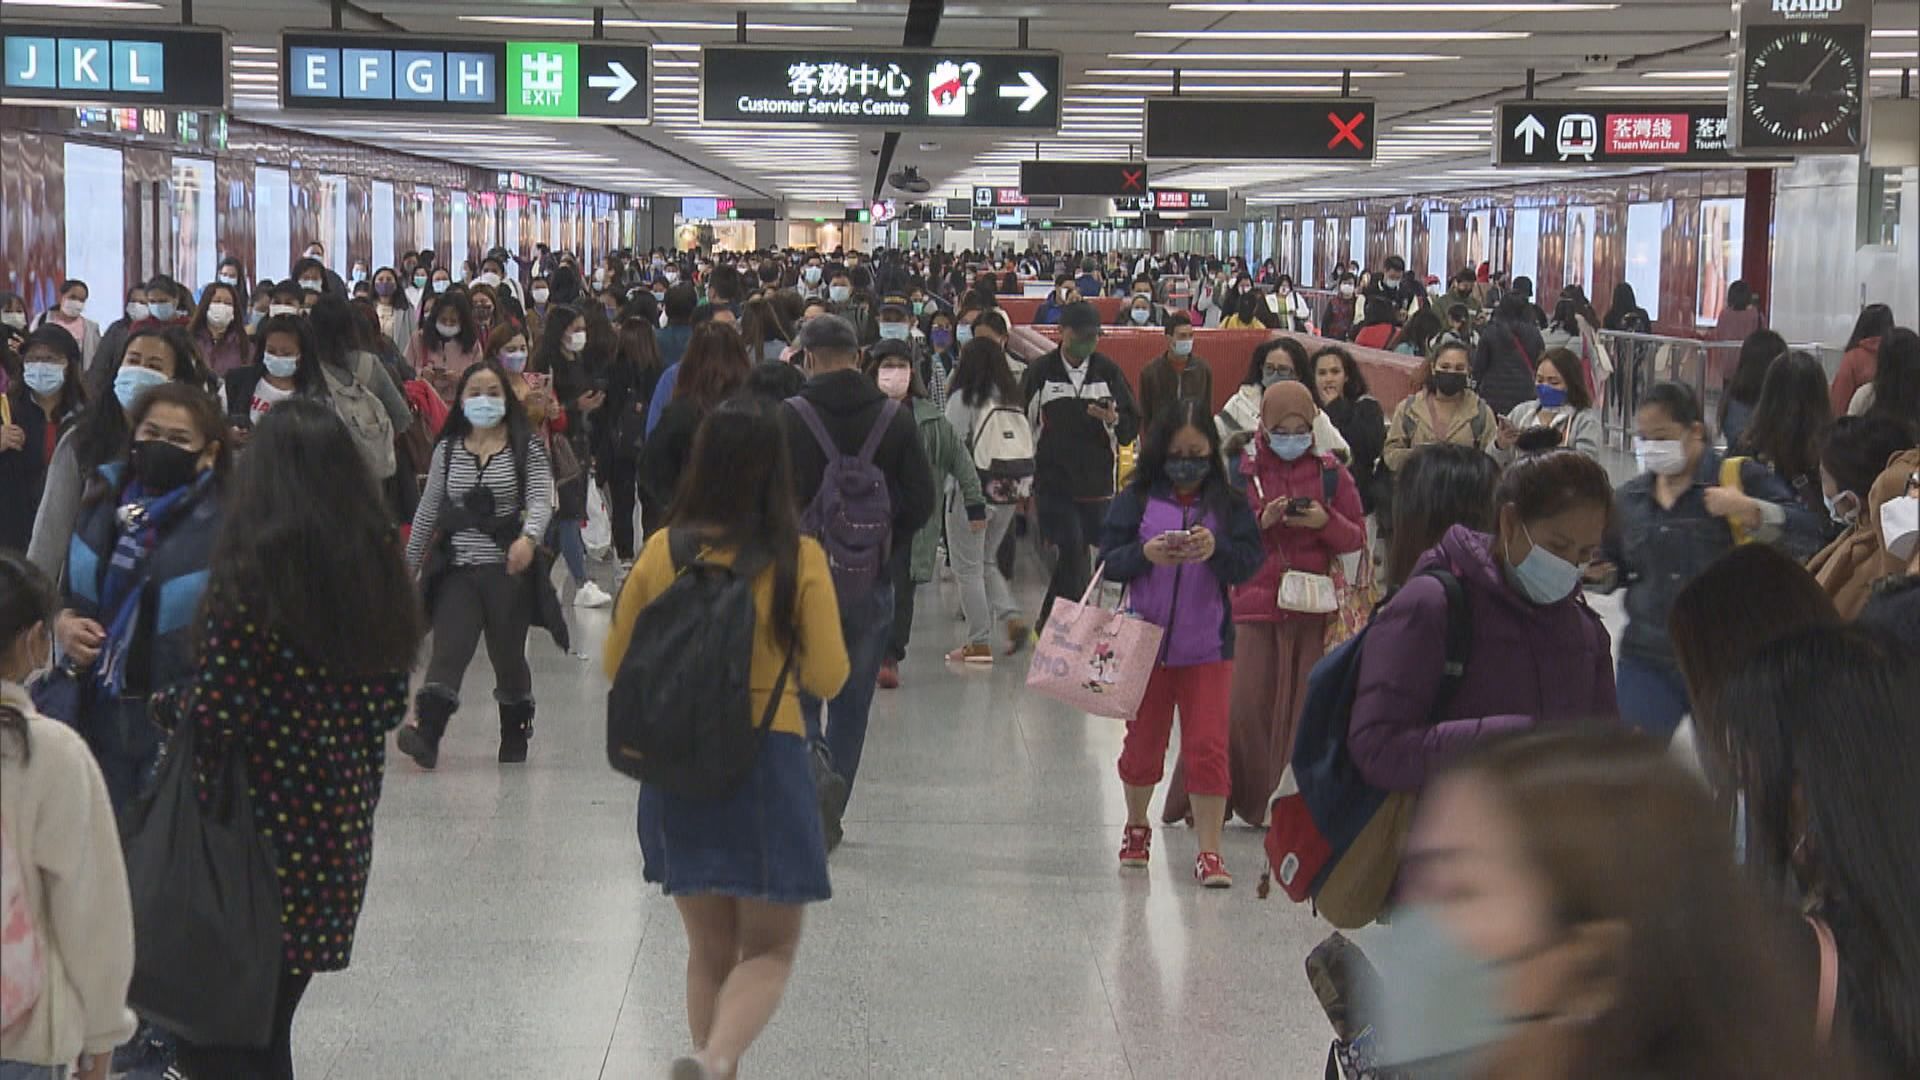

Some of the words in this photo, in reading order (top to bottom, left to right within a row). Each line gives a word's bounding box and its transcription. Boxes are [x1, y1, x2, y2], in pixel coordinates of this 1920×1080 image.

[20, 45, 37, 80] J
[74, 47, 99, 82] K
[129, 50, 150, 85] L
[307, 55, 327, 89] E
[359, 58, 378, 91] F
[406, 60, 433, 93] G
[459, 61, 484, 95] H
[787, 61, 911, 96] 客務中心
[522, 87, 563, 106] EXIT
[737, 96, 806, 114] Customer
[807, 97, 860, 115] Service
[862, 99, 910, 116] Centre
[1612, 140, 1638, 150] Tsuen
[1639, 140, 1660, 150] Wan
[1661, 140, 1681, 150] Line
[1695, 139, 1722, 150] Tsuen
